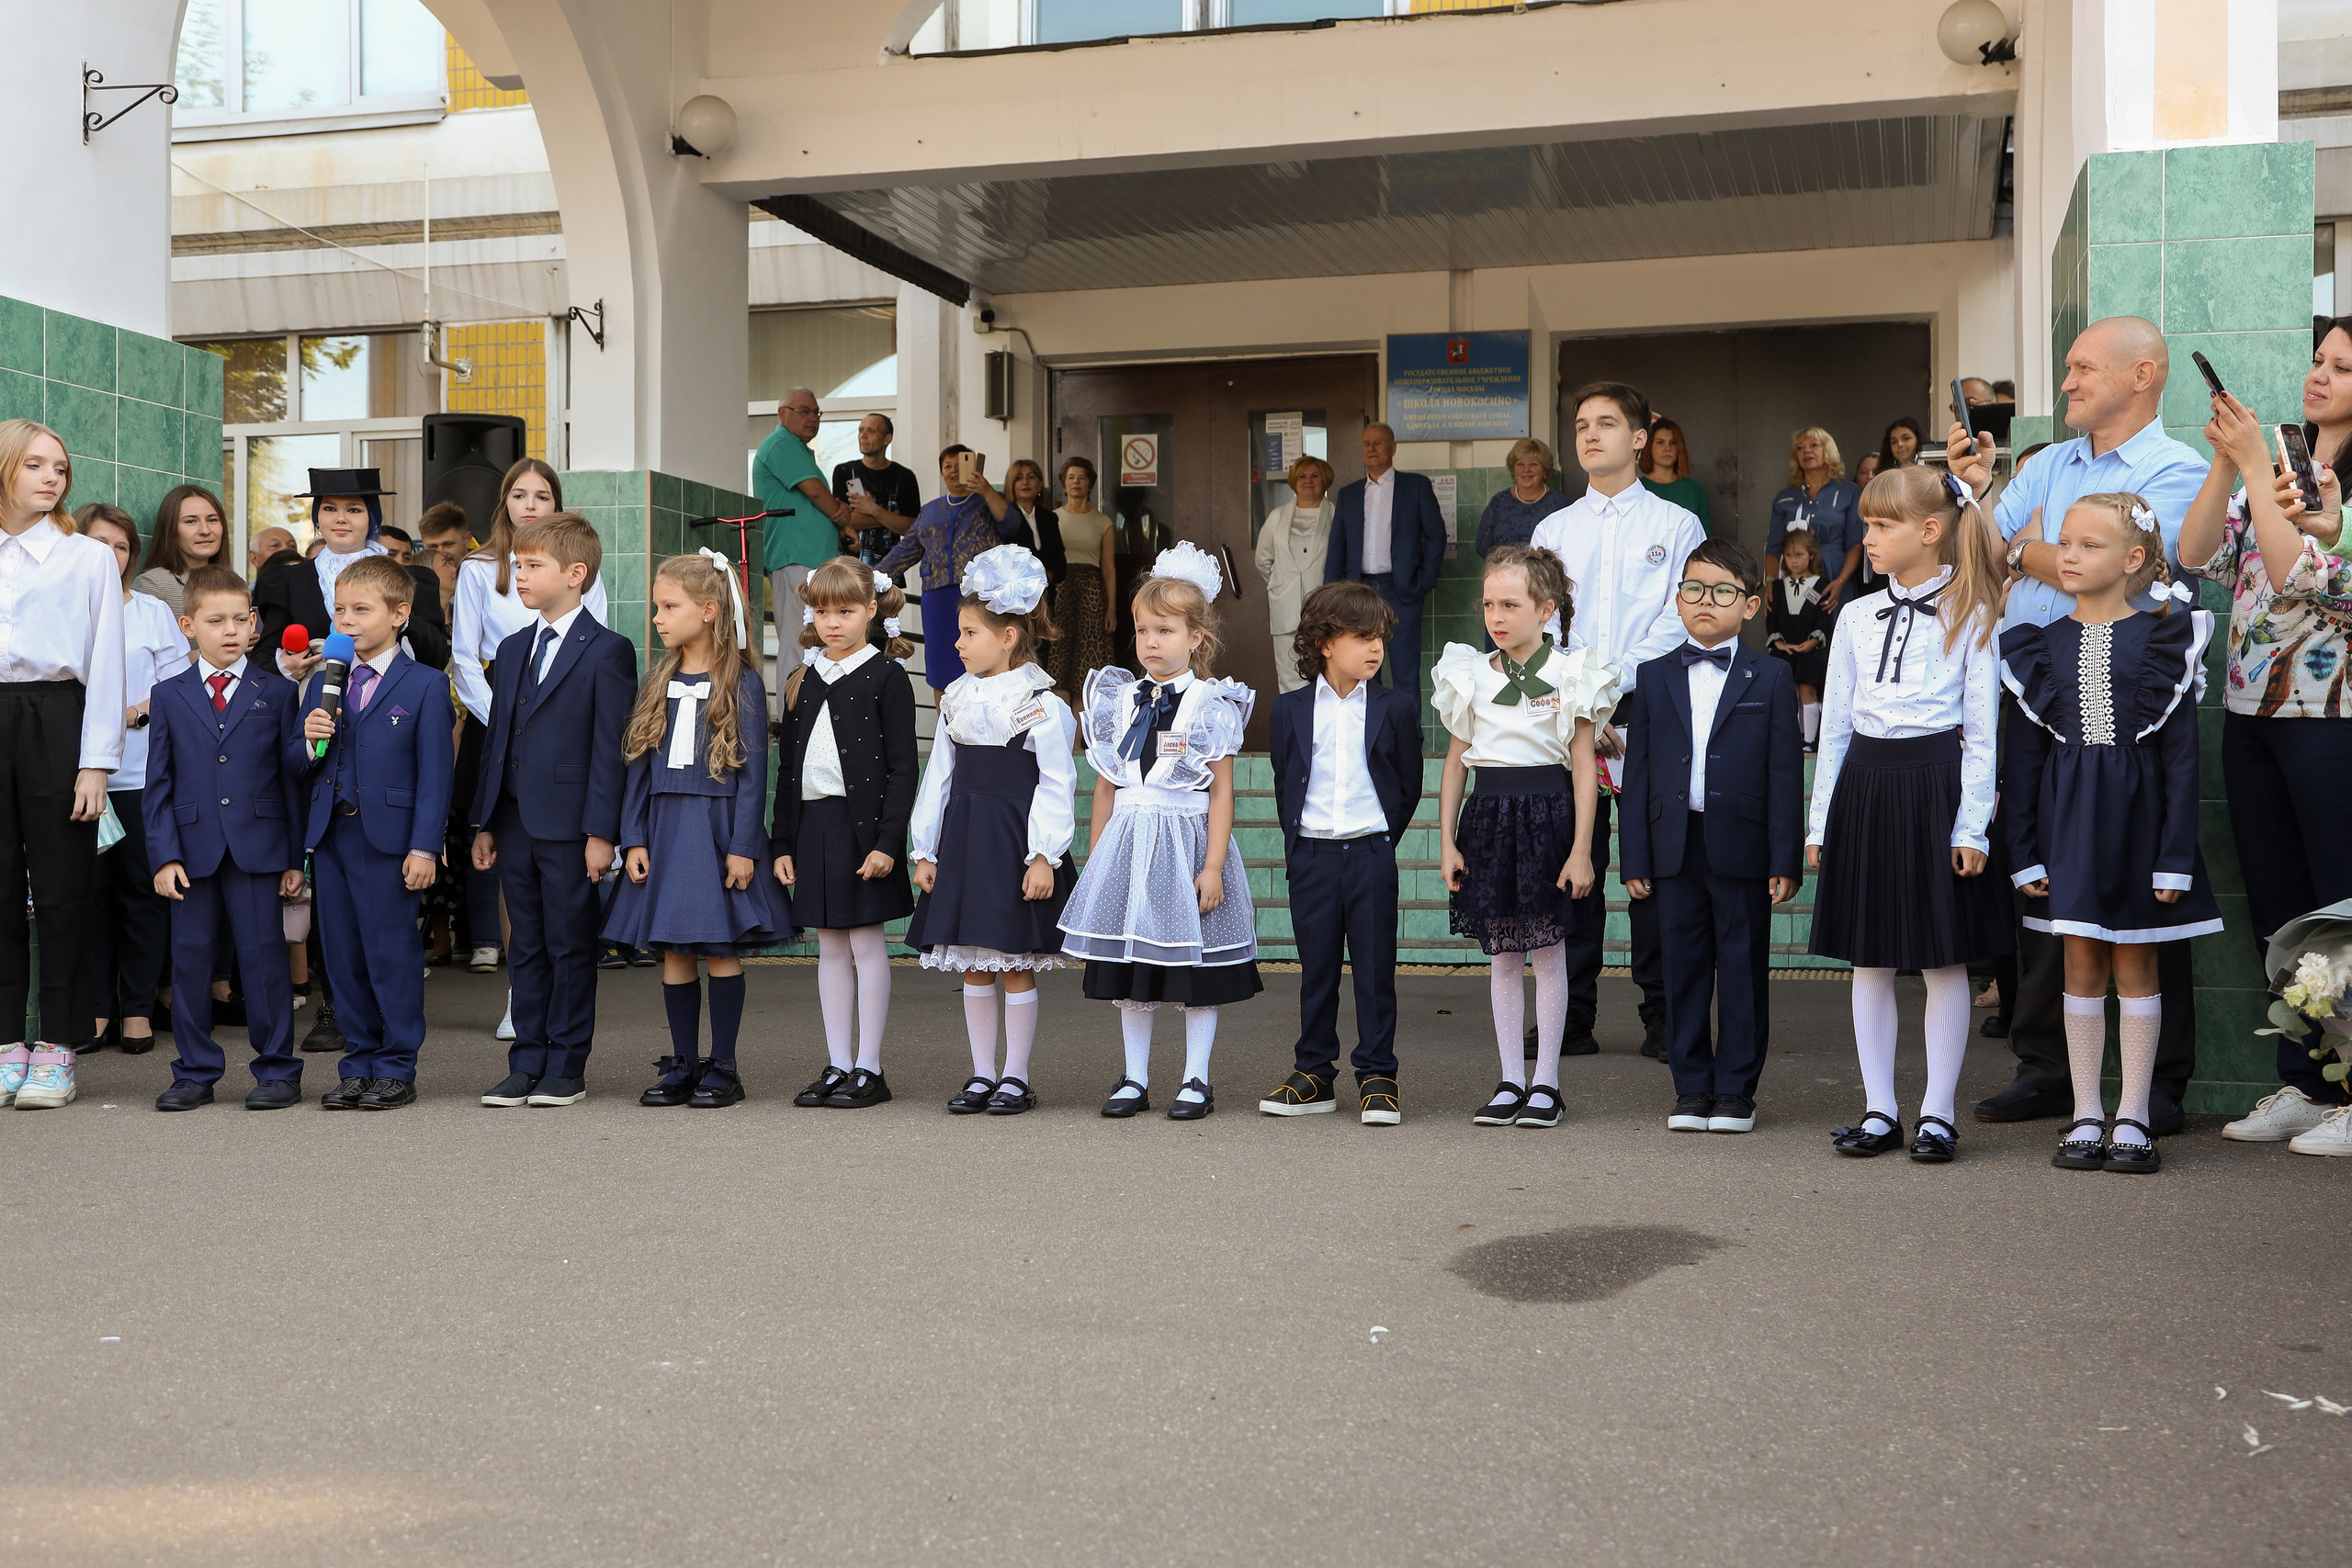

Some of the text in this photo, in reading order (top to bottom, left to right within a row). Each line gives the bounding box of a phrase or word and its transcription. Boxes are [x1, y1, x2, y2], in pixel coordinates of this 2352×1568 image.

[1404, 368, 1466, 377] ГОСУДАРСТВЕННОЕ
[1394, 375, 1521, 385] ОБЩЕОБРАЗОВАТЕЛЬНОЕ УЧРЕЖДЕНИЕ
[1531, 698, 1550, 707] Софа
